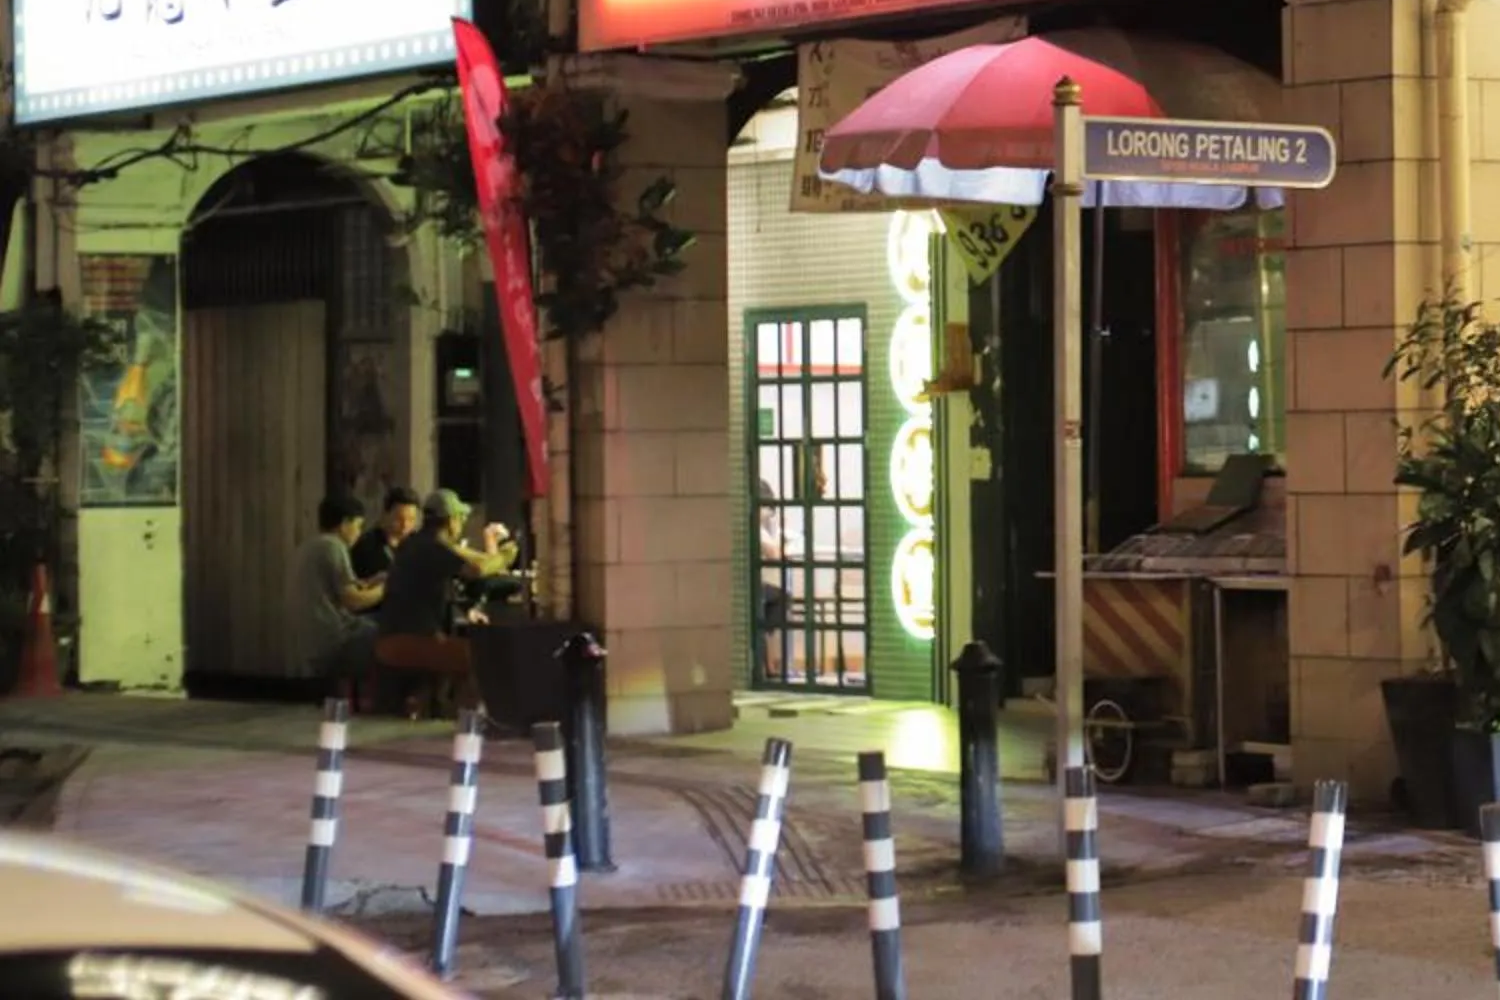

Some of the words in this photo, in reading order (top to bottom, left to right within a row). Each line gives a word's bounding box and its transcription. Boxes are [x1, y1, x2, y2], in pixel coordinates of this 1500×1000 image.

[1107, 128, 1189, 159] LORONG
[1195, 132, 1290, 163] PETALING
[1295, 137, 1308, 164] 2
